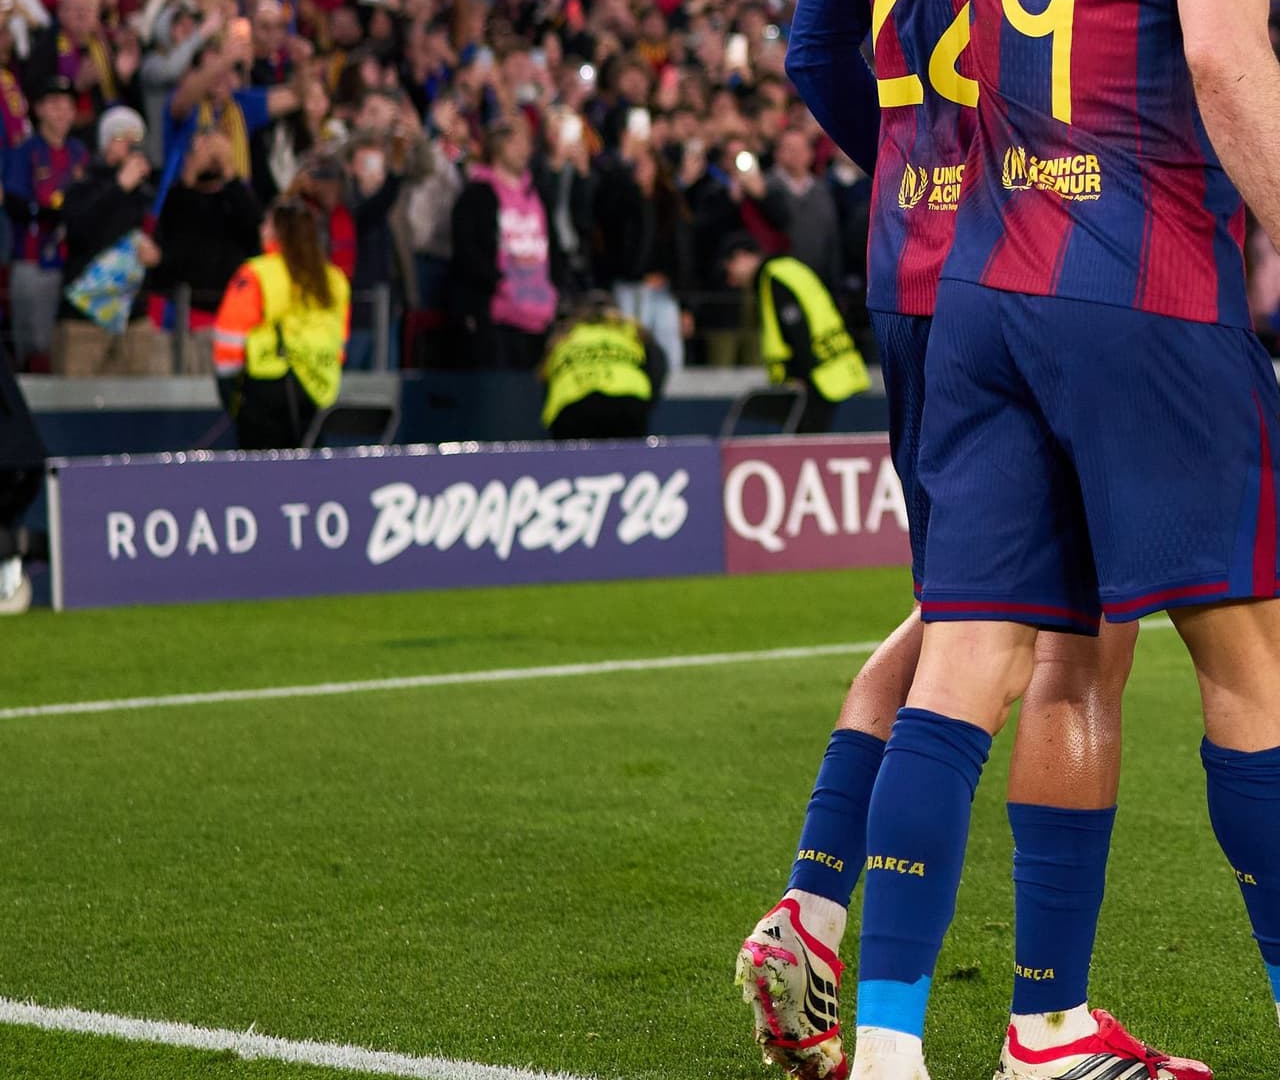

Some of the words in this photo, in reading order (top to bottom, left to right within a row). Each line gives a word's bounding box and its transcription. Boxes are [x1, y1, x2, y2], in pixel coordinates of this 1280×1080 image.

[107, 507, 258, 560] ROAD
[281, 502, 349, 551] TO
[367, 473, 625, 565] BUDAPEST
[618, 469, 689, 545] 26
[723, 457, 909, 553] QATA
